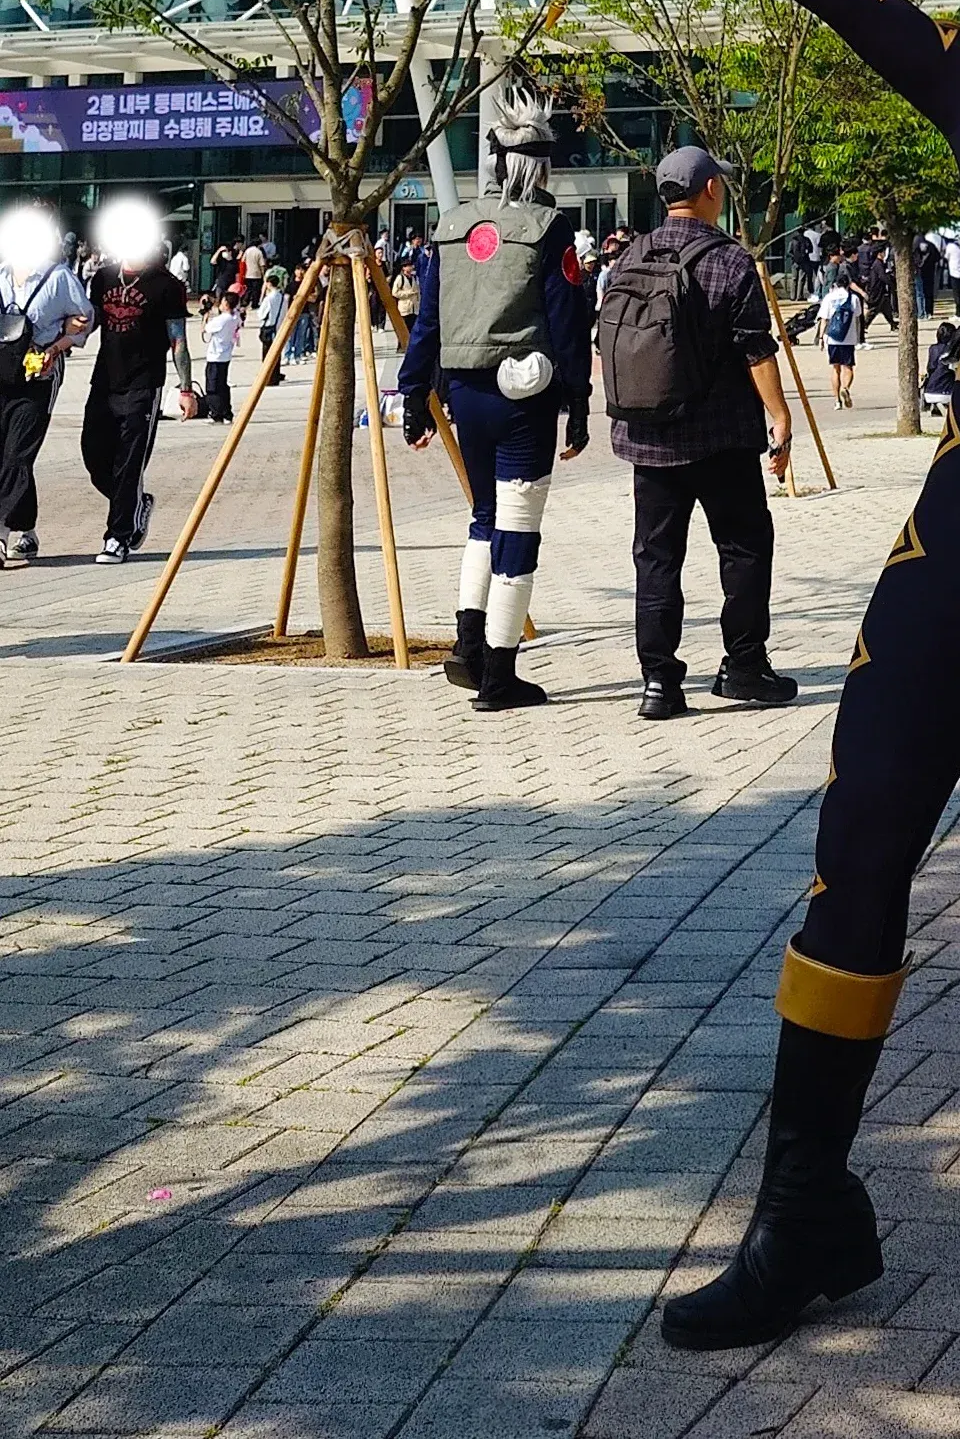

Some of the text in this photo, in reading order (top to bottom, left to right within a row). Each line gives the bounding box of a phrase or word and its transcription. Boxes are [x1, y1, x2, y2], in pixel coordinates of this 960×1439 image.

[87, 94, 115, 116] 2홀
[119, 93, 150, 115] 내부
[82, 115, 269, 142] 입장팔찌를 수령해 주세요.
